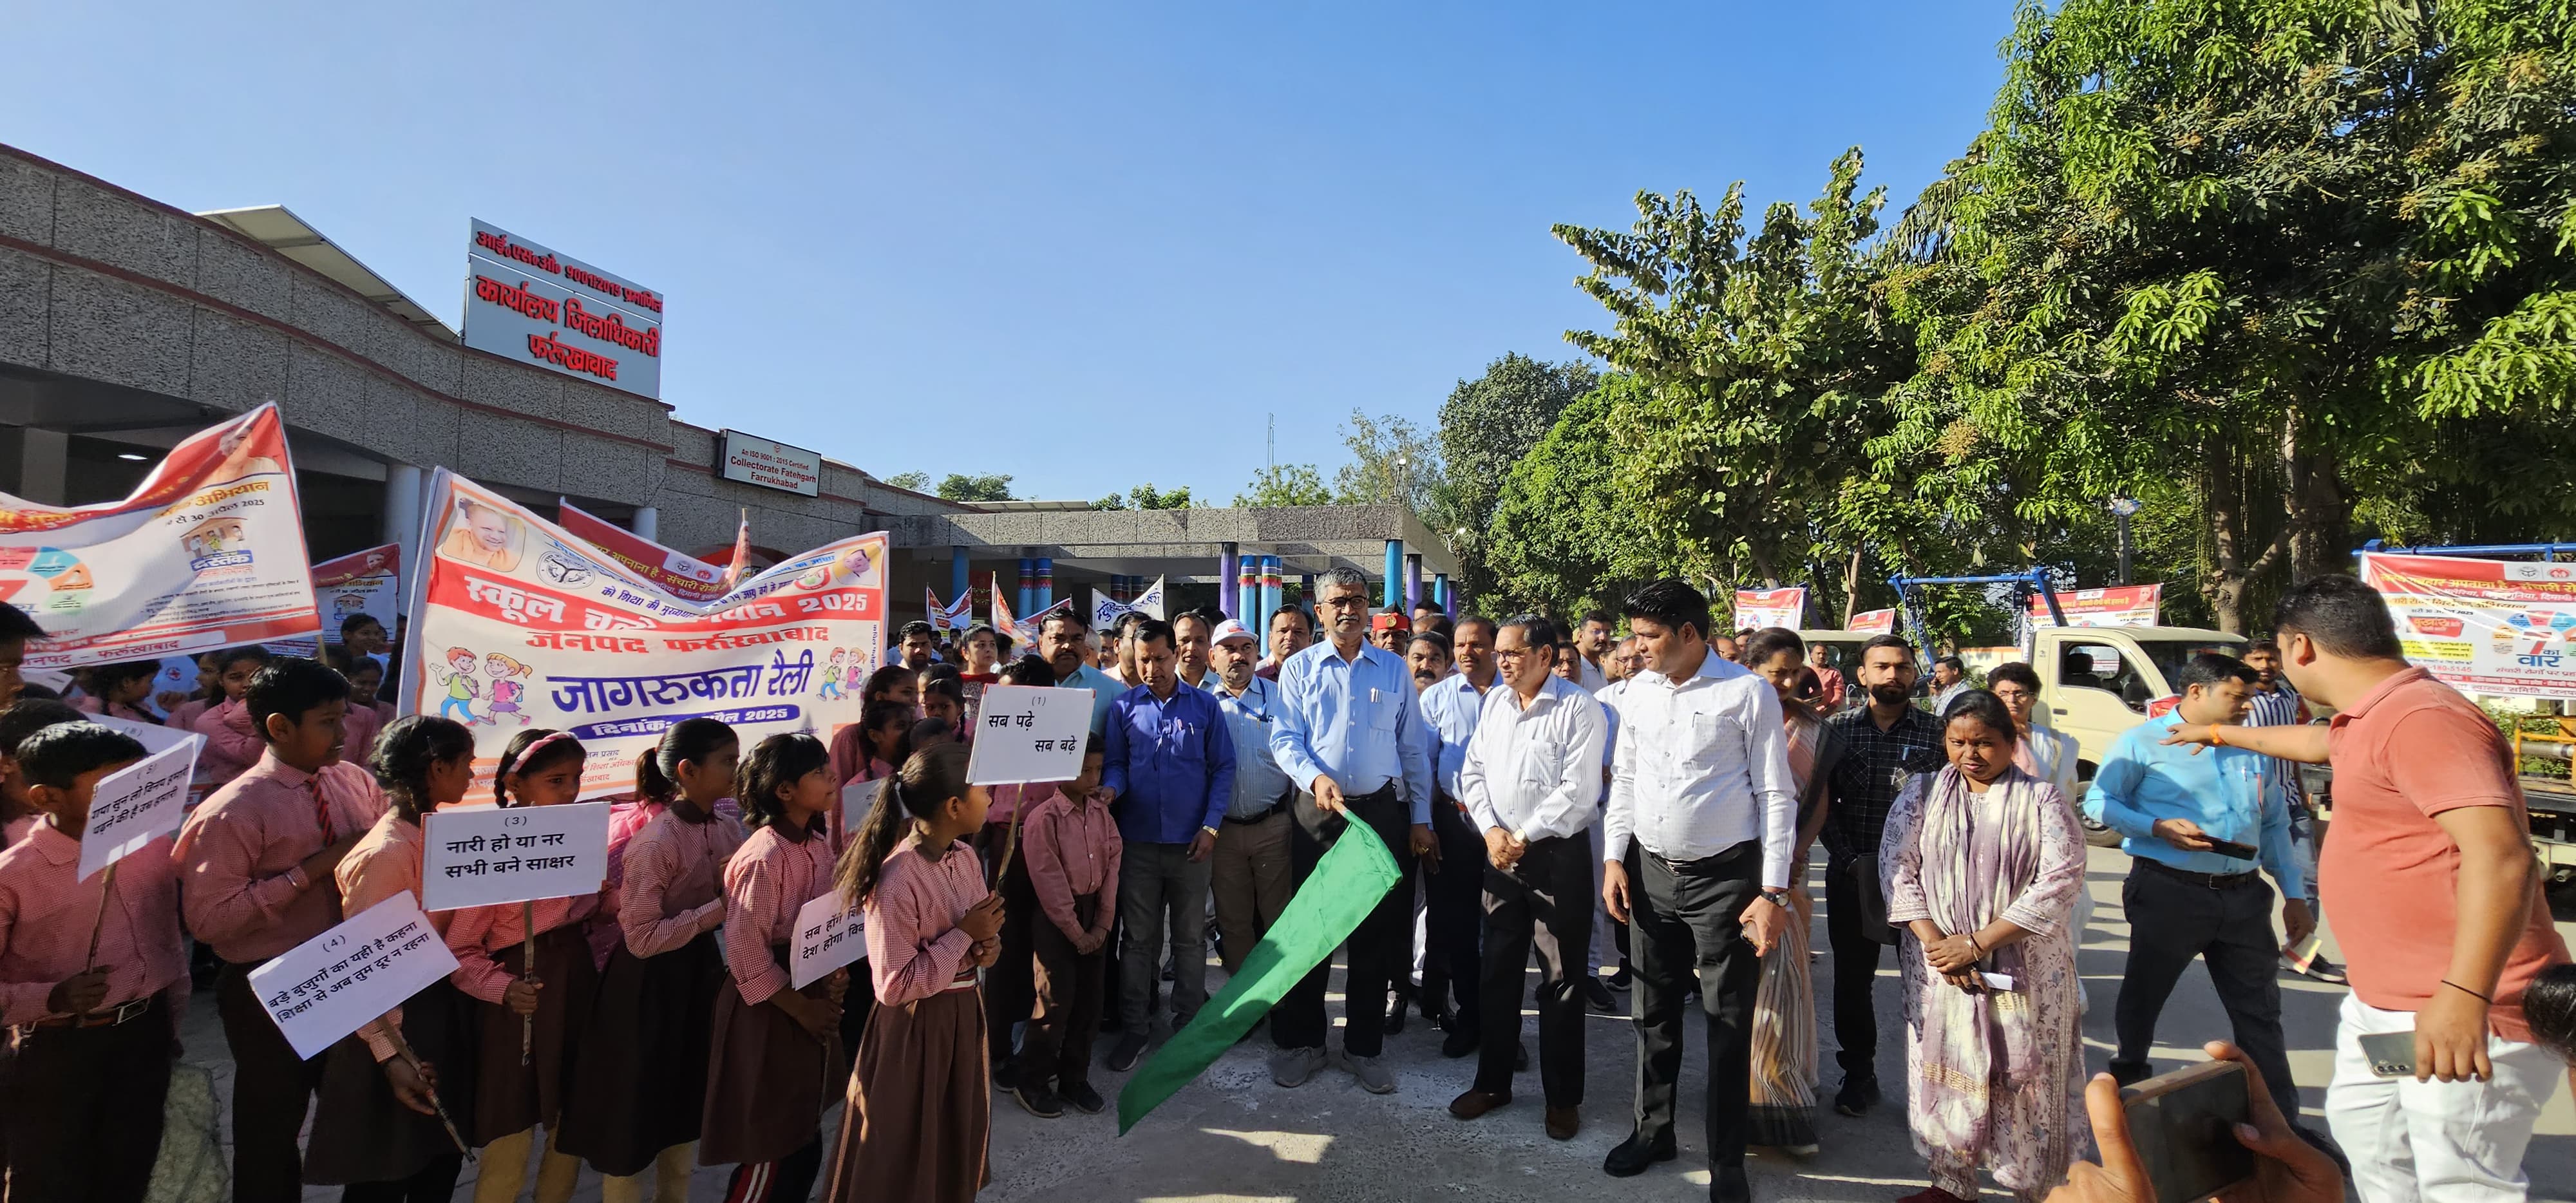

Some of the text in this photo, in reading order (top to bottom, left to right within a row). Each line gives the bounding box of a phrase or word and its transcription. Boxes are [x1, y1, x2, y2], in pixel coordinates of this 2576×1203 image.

[477, 274, 660, 357] कार्यालय जिलाधिकारी
[731, 456, 816, 482] Collectorate Fatehgarh
[760, 453, 772, 461] 9001
[777, 457, 788, 466] 2015
[789, 460, 809, 470] Certified
[751, 472, 798, 489] Farrukhabad
[195, 482, 270, 507] अभियान
[666, 574, 697, 590] संचारी
[464, 575, 567, 623] स्कूल
[798, 594, 867, 612] 2025
[618, 590, 645, 606] शिक्षा
[647, 599, 660, 611] की
[526, 631, 650, 653] जनपद
[2516, 654, 2564, 667] वार
[768, 649, 814, 696] रैली
[745, 708, 788, 720] 2025
[989, 710, 1035, 731] सब पढ़े
[1035, 735, 1077, 755] सब बढ़े
[116, 807, 129, 823] की
[131, 804, 138, 819] है
[446, 833, 565, 854] नारी हो या नर
[445, 855, 576, 878] सभी बने साक्षर
[805, 925, 822, 940] सब
[802, 944, 819, 960] देश
[823, 931, 844, 951] होगा
[268, 990, 290, 1009] बड़े
[330, 959, 349, 974] का
[350, 945, 374, 963] यही
[374, 938, 385, 951] है
[385, 921, 418, 942] कहना
[276, 932, 430, 1023] शिक्षा से अब तुम दूर न रहना
